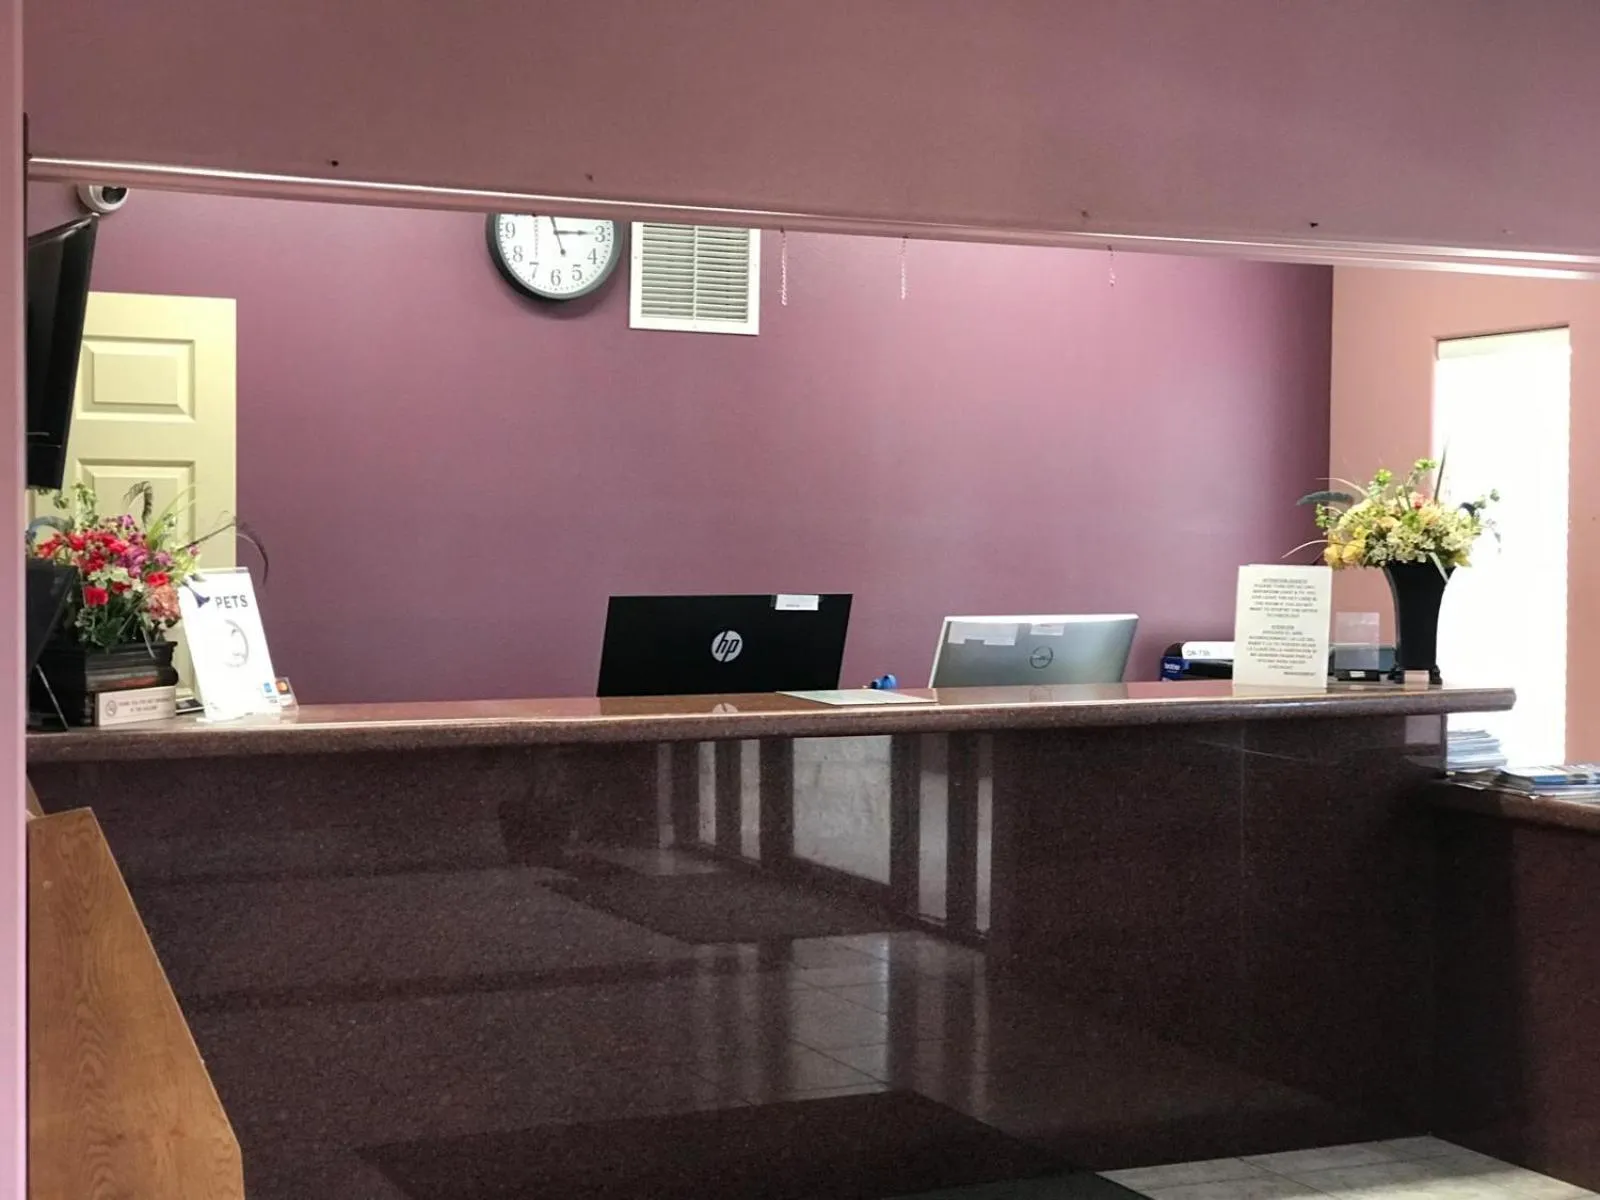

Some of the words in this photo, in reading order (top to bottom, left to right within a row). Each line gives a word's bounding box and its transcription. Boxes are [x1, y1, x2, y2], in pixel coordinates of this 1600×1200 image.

[505, 222, 516, 239] 9
[594, 225, 605, 243] 3
[513, 245, 523, 262] 8
[587, 248, 598, 265] 4
[529, 261, 540, 279] 7
[550, 269, 561, 287] 6
[571, 264, 583, 281] 5
[215, 594, 249, 609] PETS
[712, 630, 742, 662] hp
